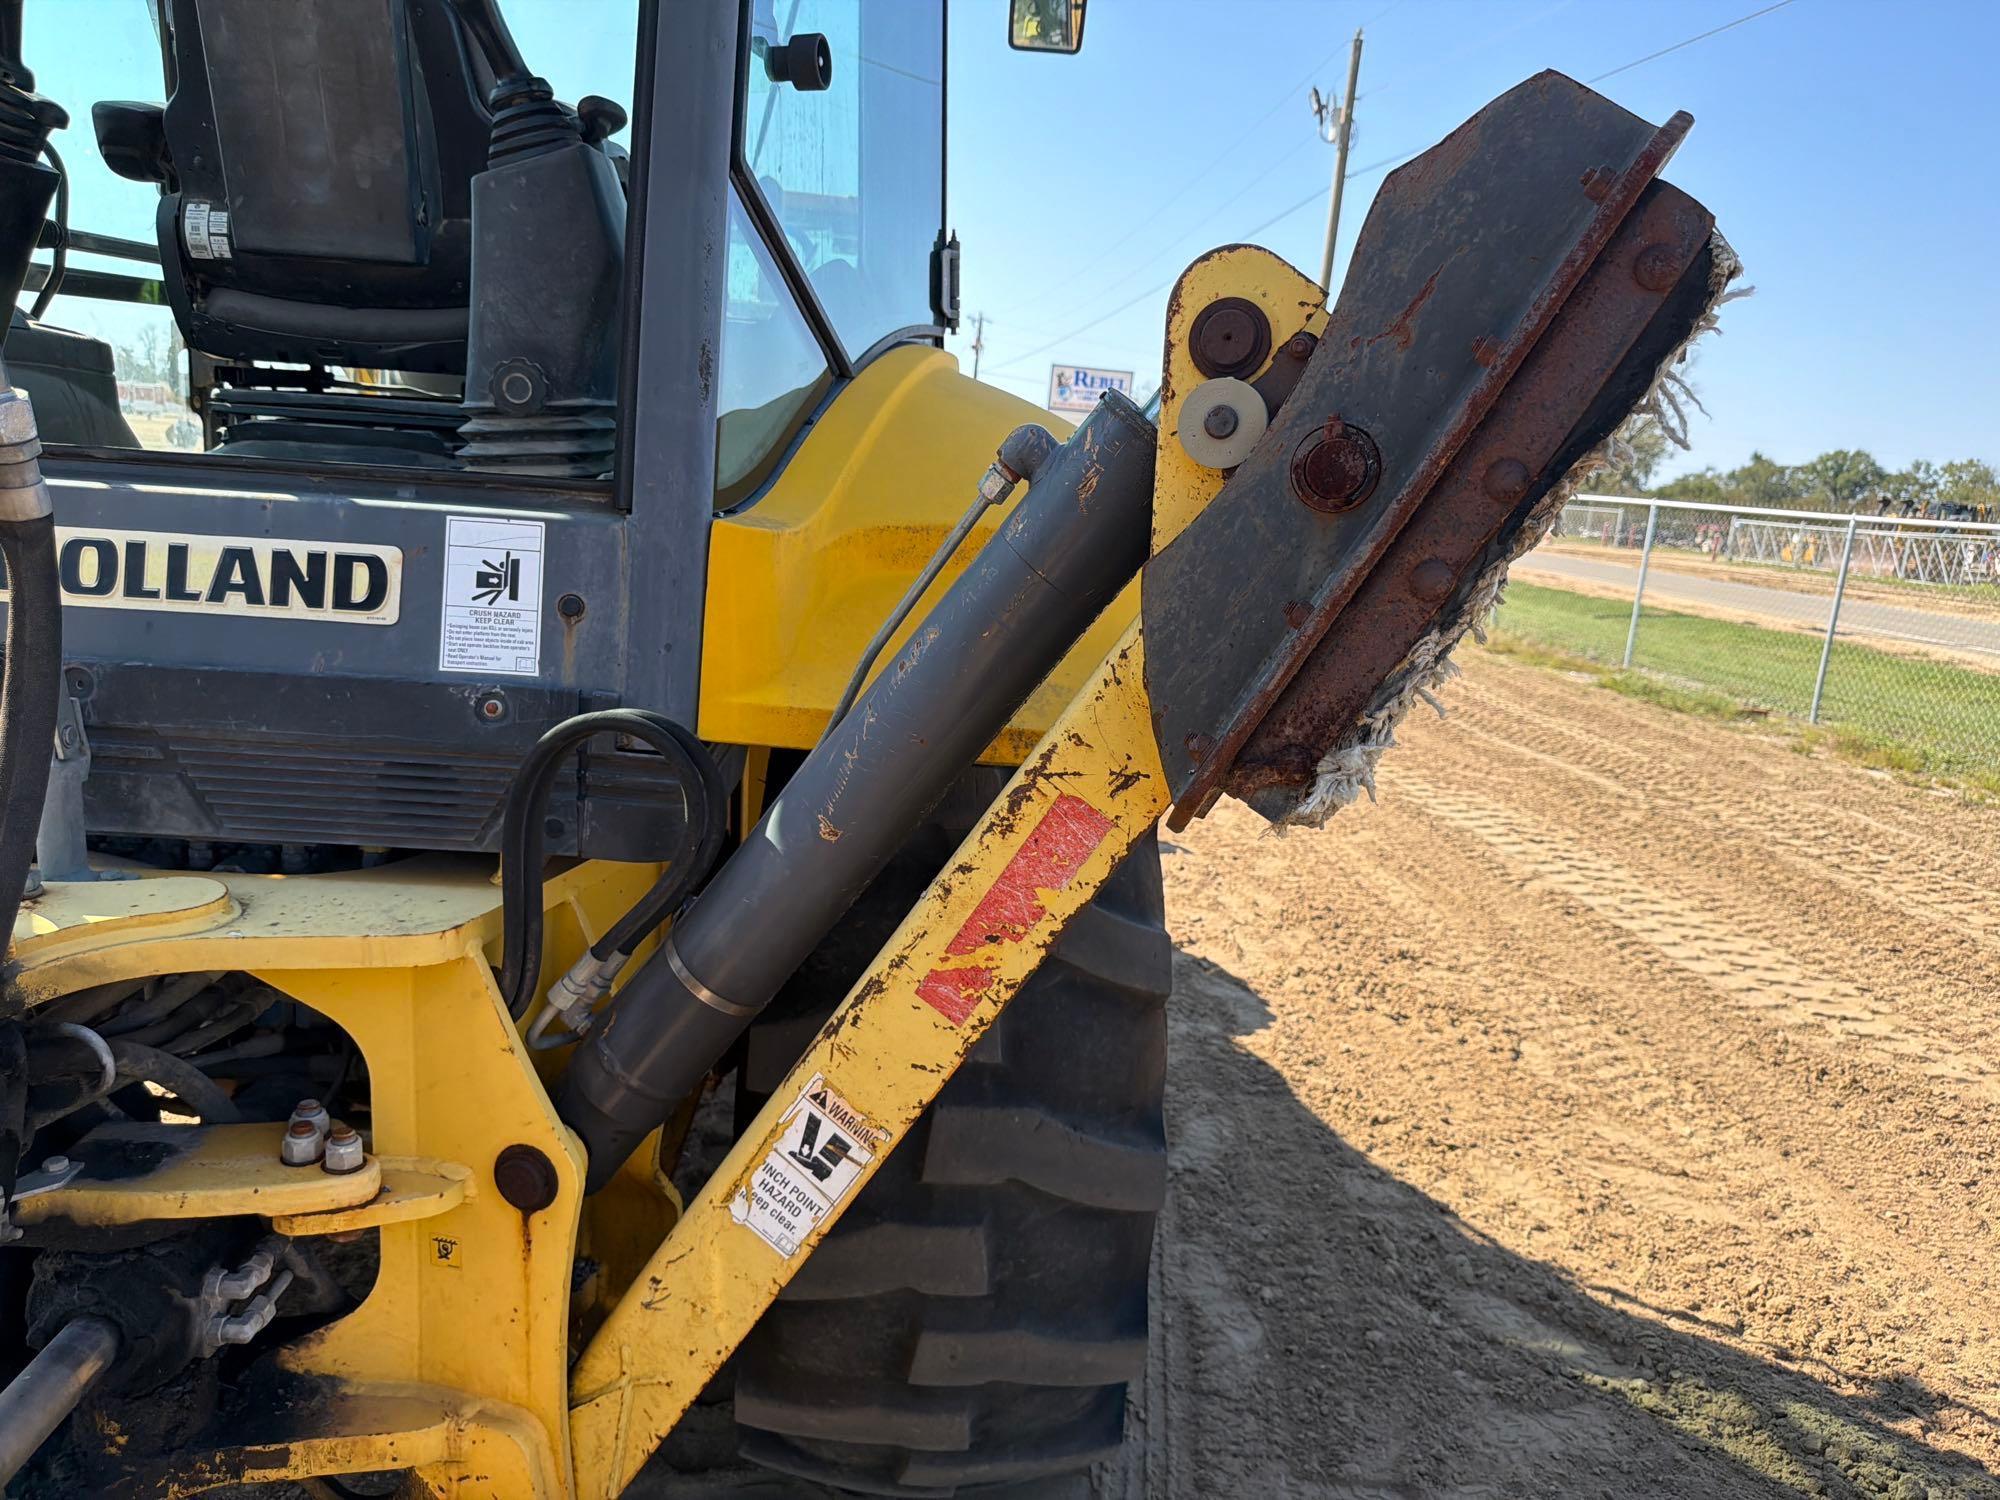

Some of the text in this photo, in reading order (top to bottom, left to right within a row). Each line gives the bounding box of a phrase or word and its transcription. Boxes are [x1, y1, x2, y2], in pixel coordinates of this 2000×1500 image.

[60, 536, 389, 613] OLLAND
[469, 609, 521, 619] CRUSH HAZARD
[758, 1178, 802, 1218] HAZARD
[762, 1162, 824, 1217] INCH POINT
[769, 1207, 797, 1235] clear.
